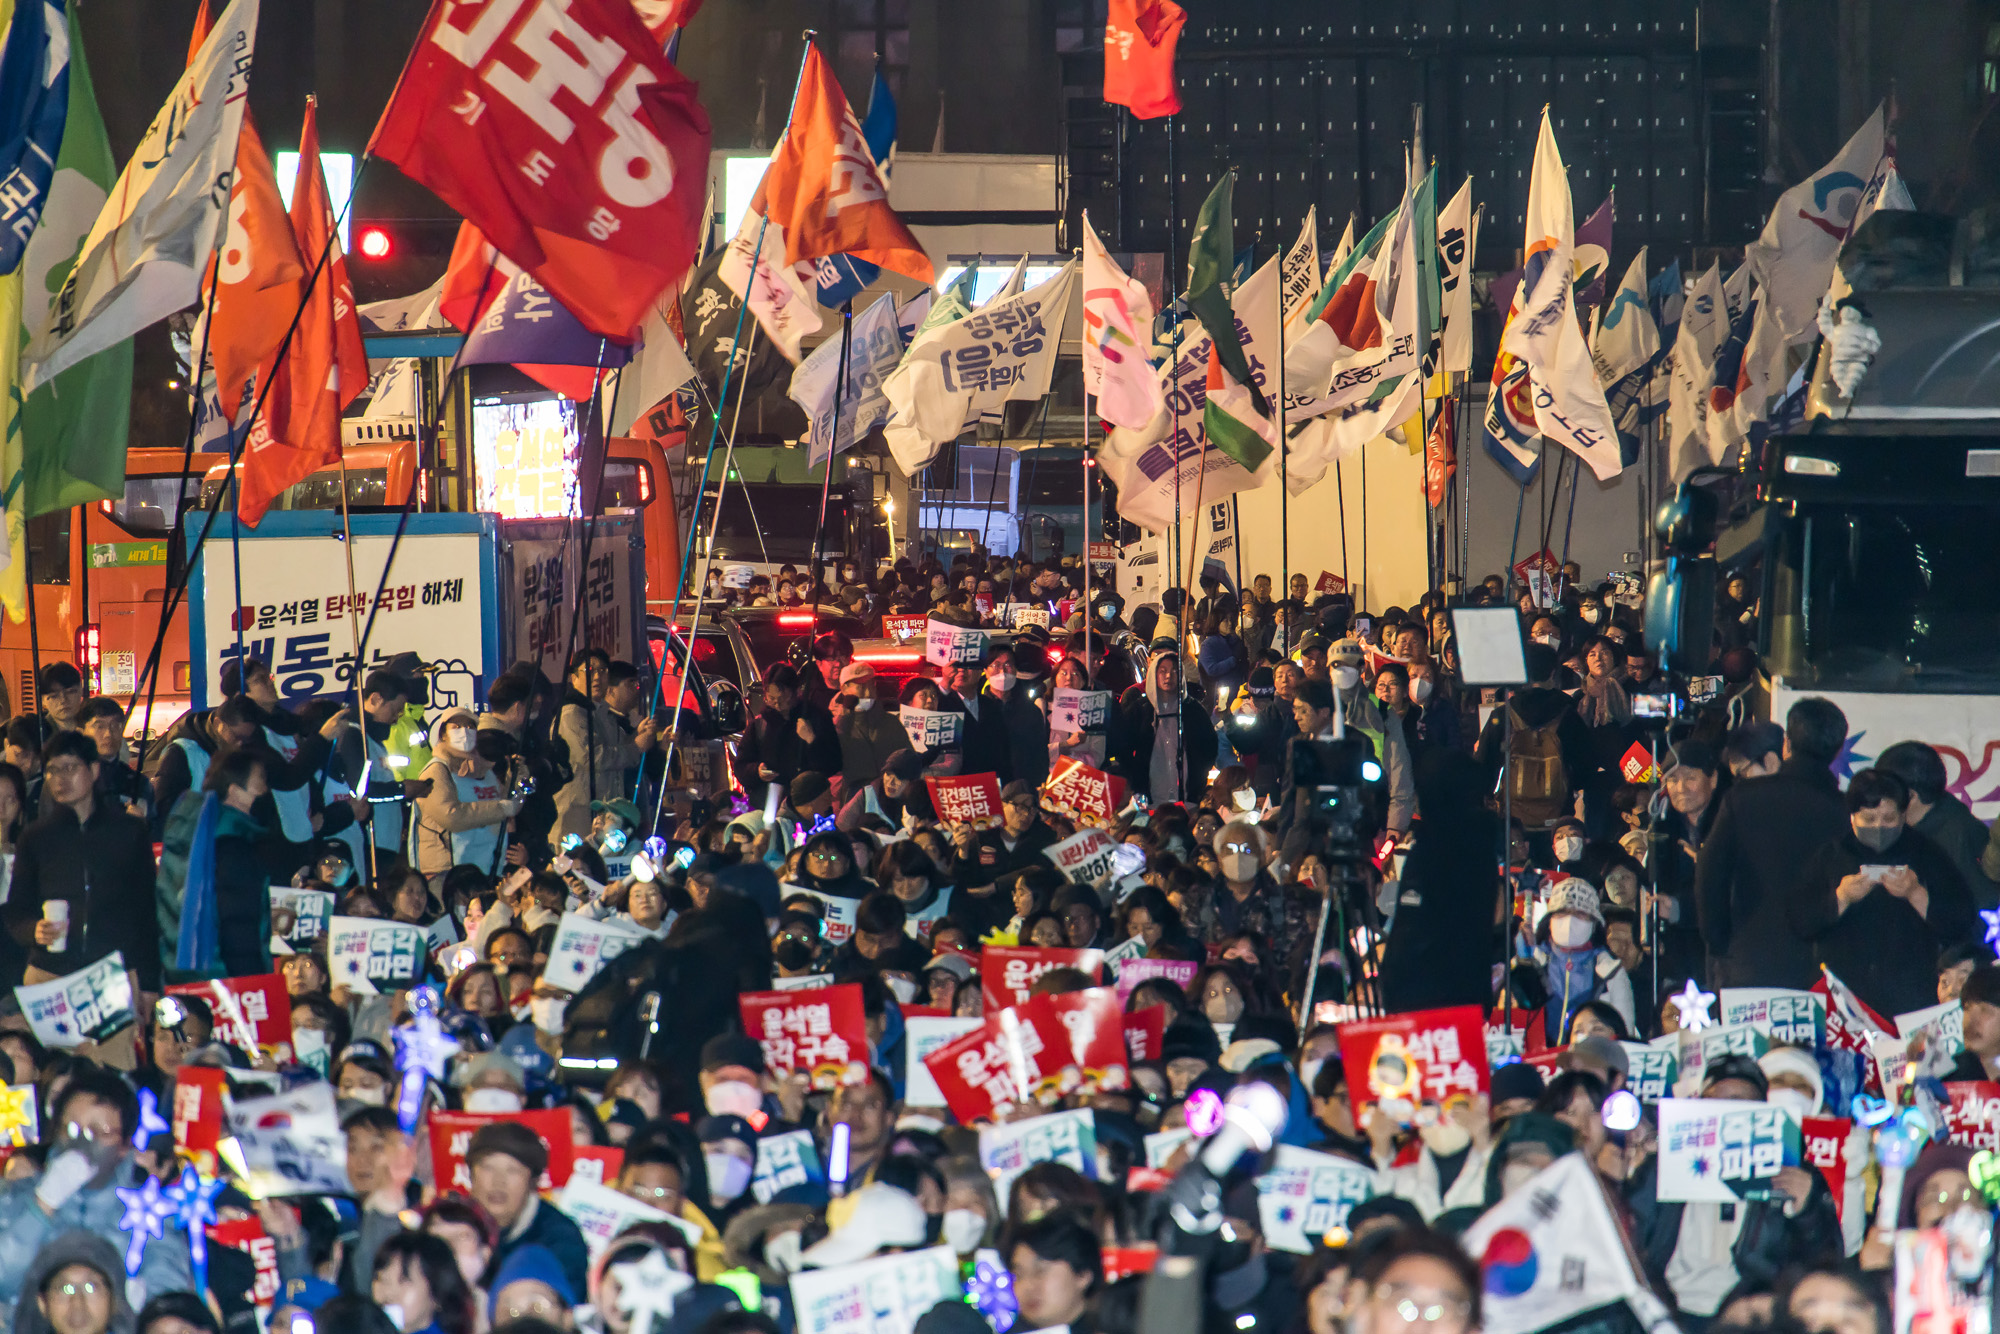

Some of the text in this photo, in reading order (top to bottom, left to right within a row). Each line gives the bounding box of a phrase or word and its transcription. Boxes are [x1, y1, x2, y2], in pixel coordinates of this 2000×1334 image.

[257, 599, 319, 630] 윤석열
[422, 577, 464, 606] 해체
[952, 630, 984, 648] 즉각
[951, 646, 982, 662] 파면
[926, 715, 957, 731] 즉각
[924, 729, 955, 746] 파면
[762, 1003, 831, 1038] 윤석열
[1719, 1108, 1784, 1147] 즉각
[1719, 1142, 1784, 1182] 파면
